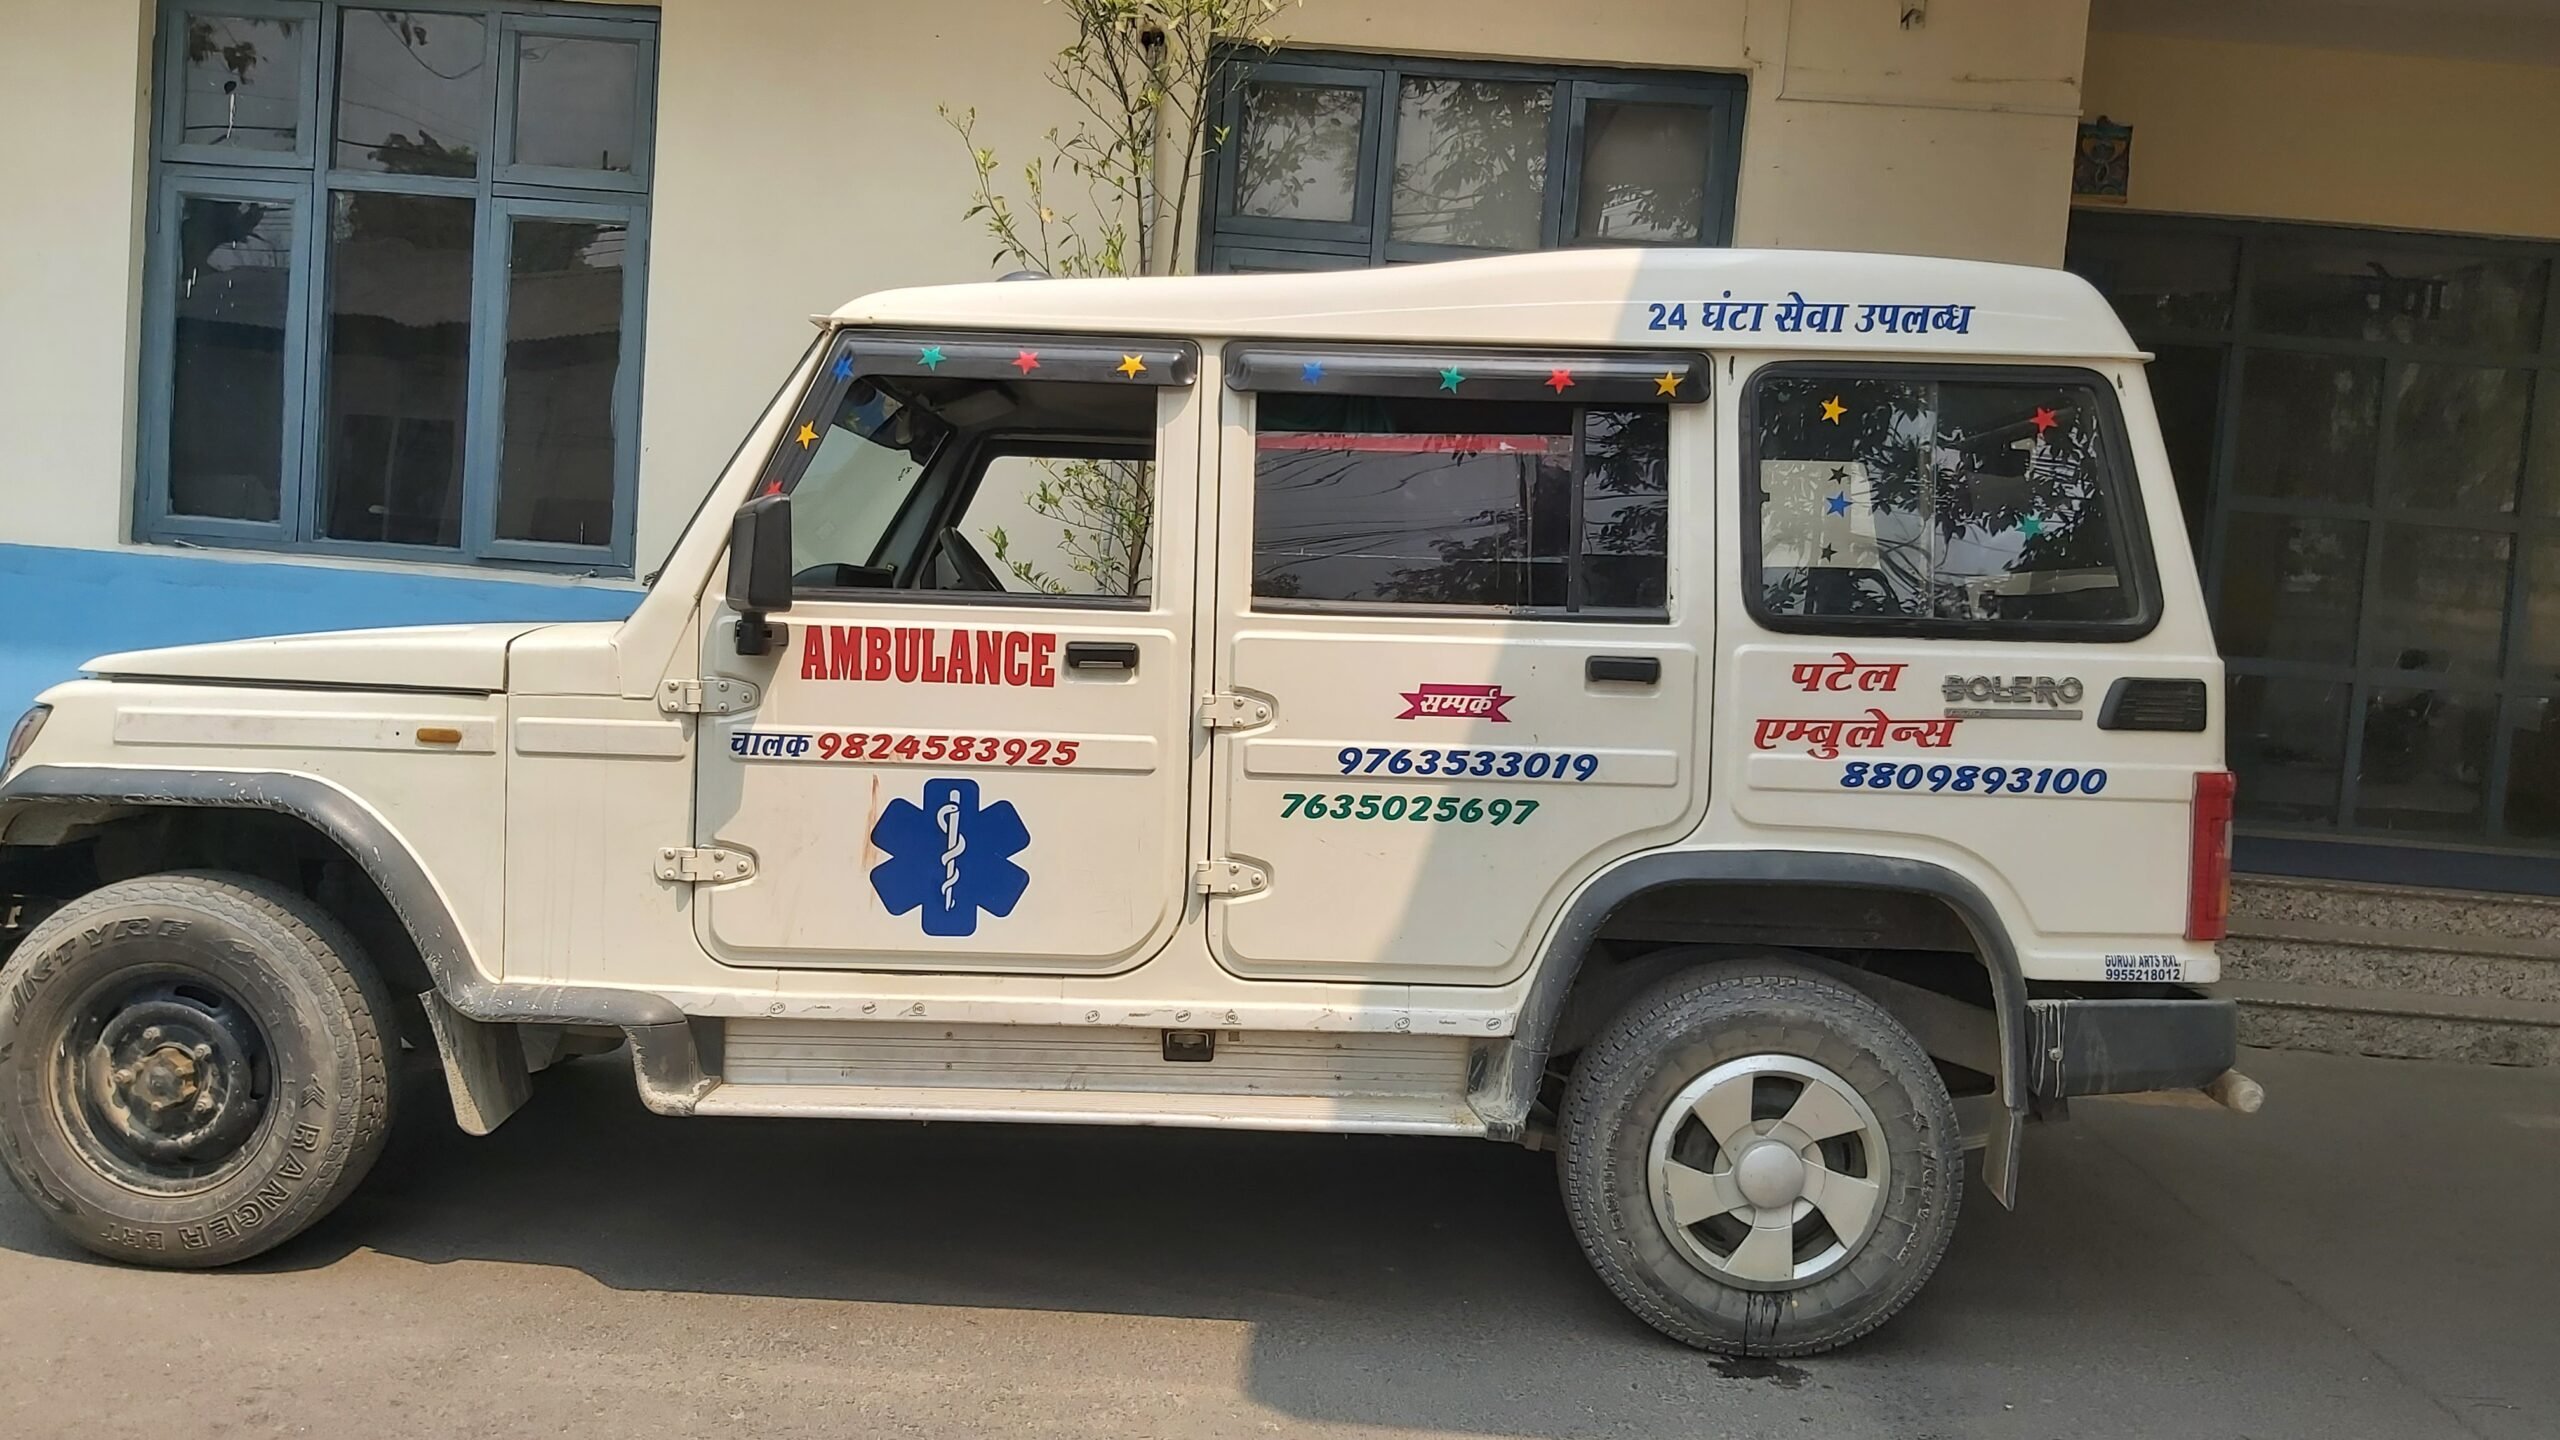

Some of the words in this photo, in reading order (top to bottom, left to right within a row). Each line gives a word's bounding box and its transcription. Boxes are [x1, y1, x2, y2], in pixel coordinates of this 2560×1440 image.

[1648, 304, 1687, 331] 24
[1701, 290, 1768, 332] घंटा
[1774, 291, 1850, 333] सेवा
[1854, 304, 1976, 334] उपलब्ध
[801, 625, 1057, 688] AMBULANCE
[1791, 652, 1909, 692] पटेल
[1419, 687, 1498, 715] सम्पर्क
[1941, 675, 2084, 707] BOLERO
[730, 731, 813, 757] चालक
[817, 732, 1080, 767] 9824583925
[1754, 708, 1963, 760] एम्बुलेन्स
[1338, 747, 1599, 782] 9763533019
[1840, 761, 2108, 795] 8809893100
[1280, 793, 1540, 826] 7635025697
[2105, 955, 2136, 968] GURUJI
[2105, 969, 2180, 980] 9955218012
[178, 1121, 323, 1250] RANGER
